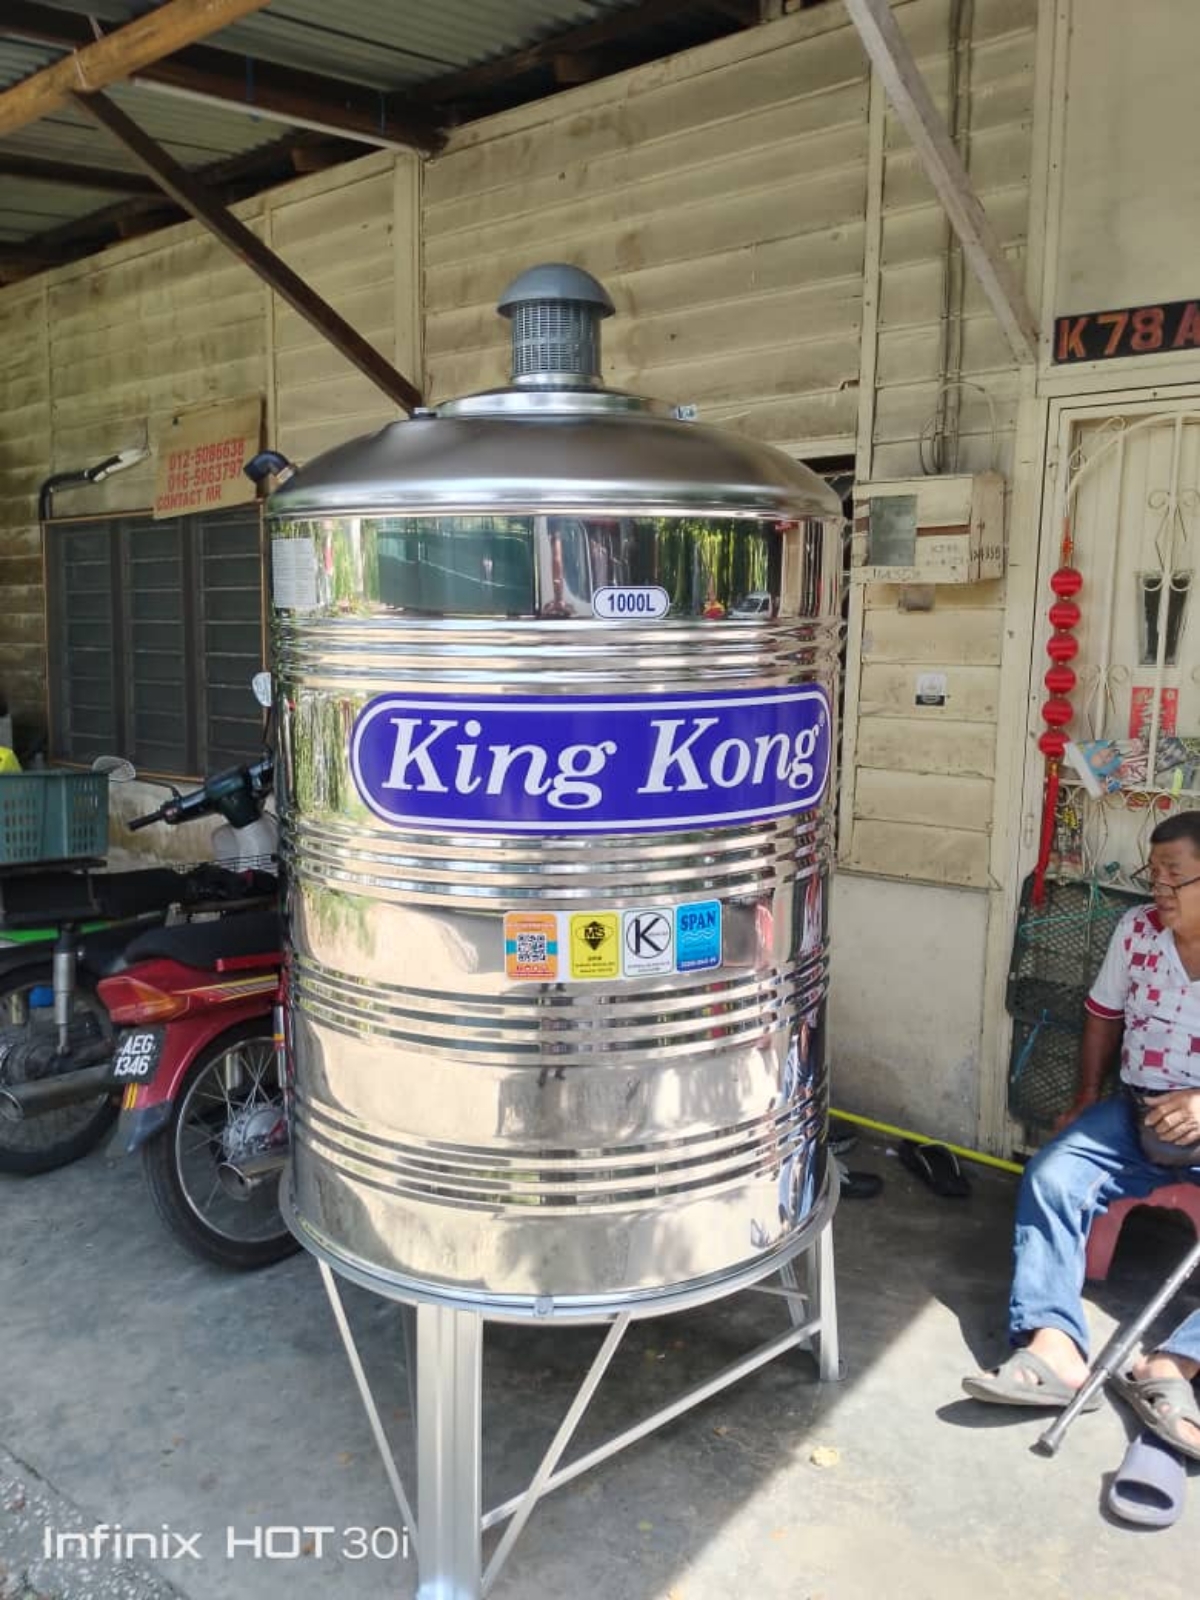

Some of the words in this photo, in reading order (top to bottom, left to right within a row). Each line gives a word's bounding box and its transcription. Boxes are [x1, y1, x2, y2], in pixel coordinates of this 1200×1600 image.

[608, 593, 656, 612] 1000L
[382, 718, 617, 810] King
[637, 717, 820, 789] Kong
[680, 911, 716, 931] SPAN
[121, 1034, 154, 1056] AEG
[113, 1055, 150, 1077] 1346
